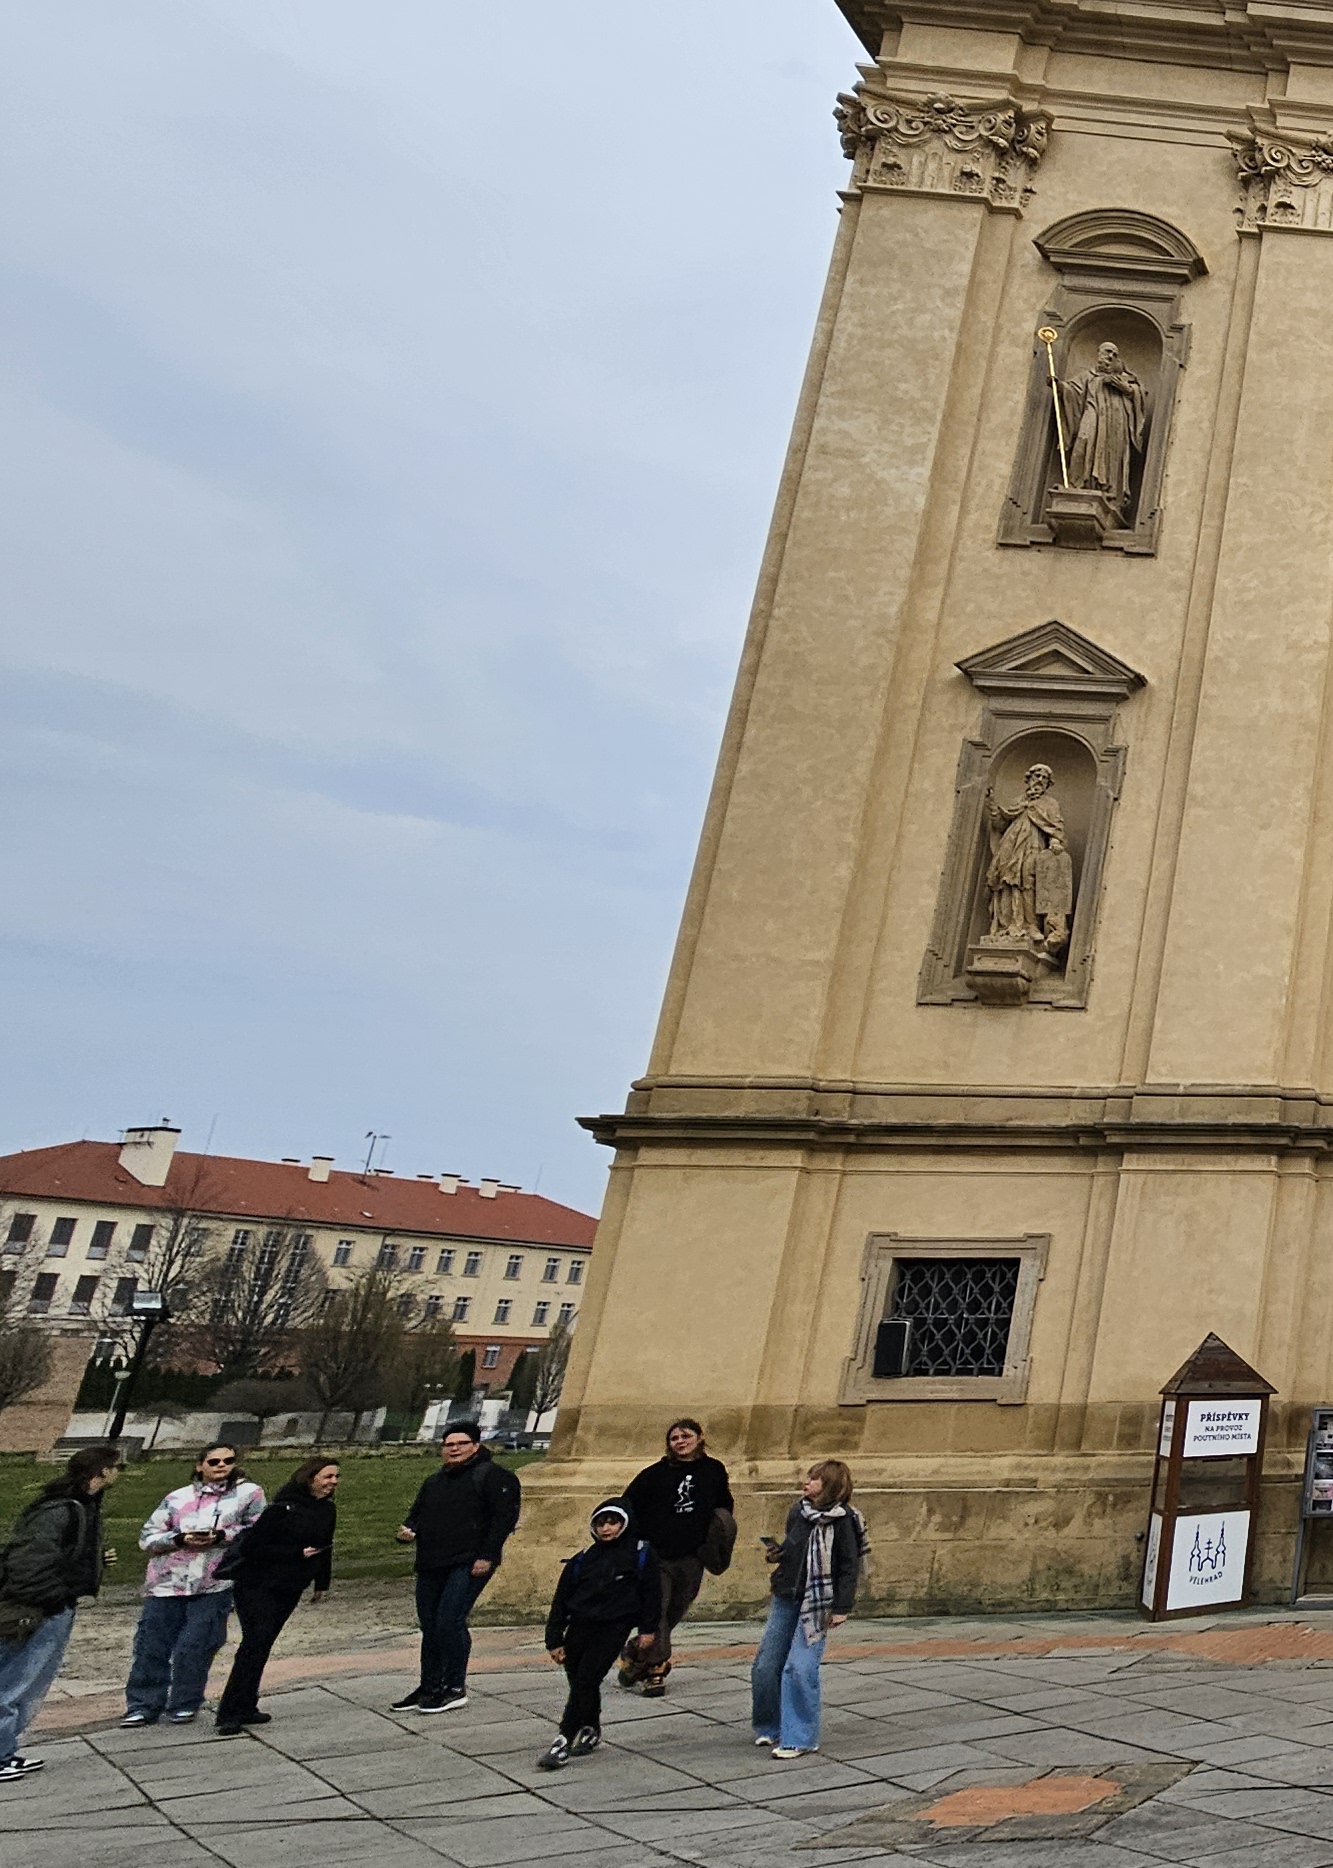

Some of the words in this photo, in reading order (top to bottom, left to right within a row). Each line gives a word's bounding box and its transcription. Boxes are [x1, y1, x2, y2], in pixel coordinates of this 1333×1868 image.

[1200, 1411, 1250, 1422] PŘÍSPĚVKY
[1216, 1424, 1243, 1432] PROVOZ
[1193, 1433, 1231, 1442] POUTNÍHO
[1189, 1571, 1223, 1585] VELEHRAD
